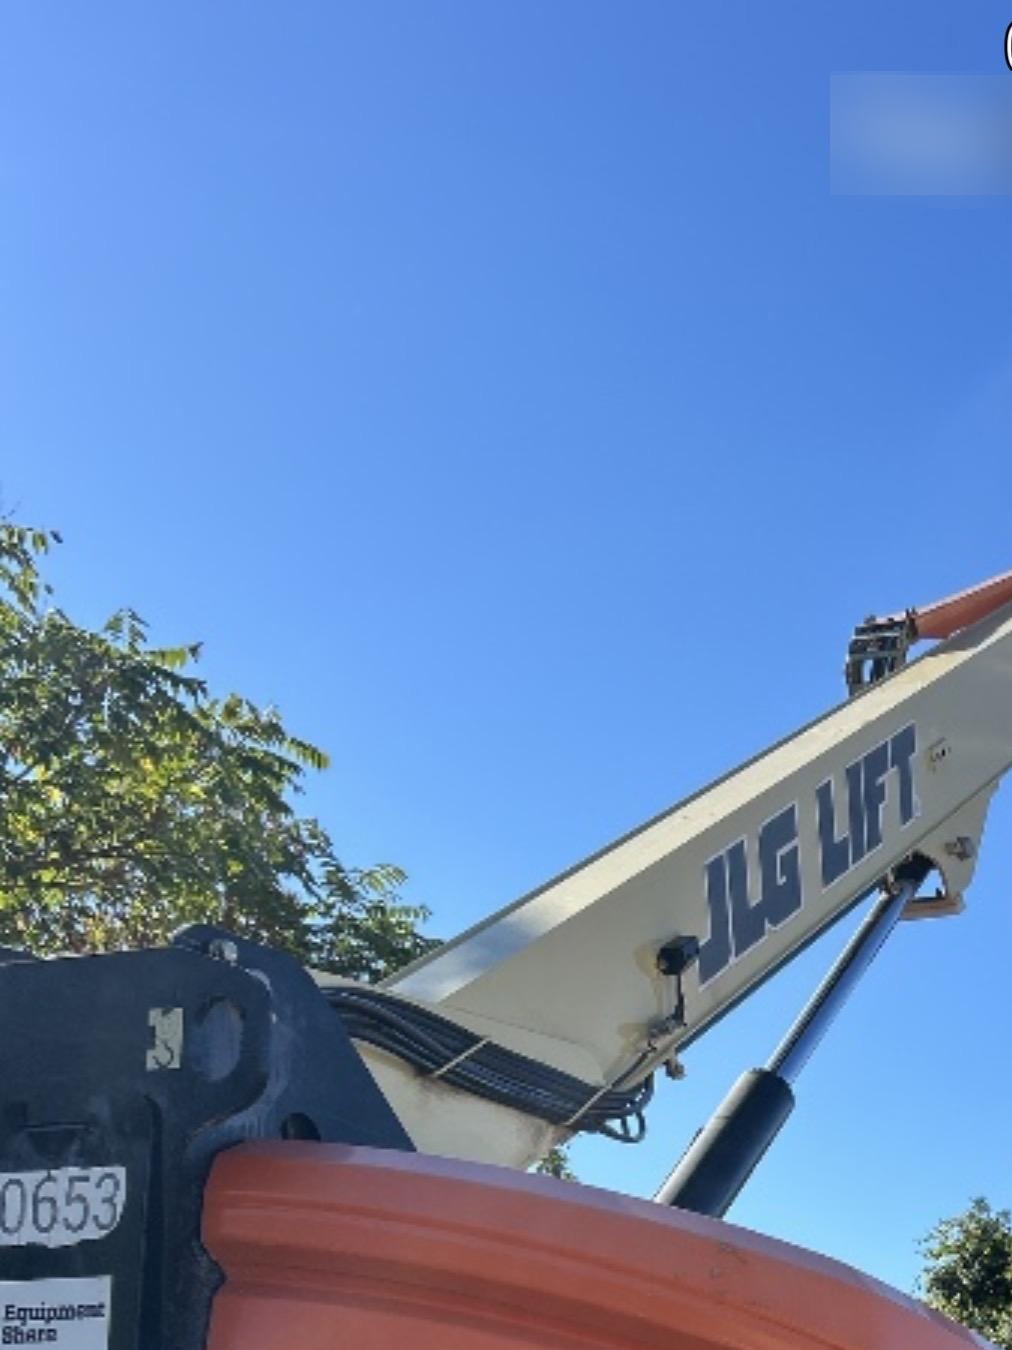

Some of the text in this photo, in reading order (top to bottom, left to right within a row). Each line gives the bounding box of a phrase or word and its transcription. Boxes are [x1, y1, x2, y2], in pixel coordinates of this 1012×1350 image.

[697, 720, 921, 991] JLG LIFT
[1, 1172, 119, 1234] 0653
[2, 1326, 57, 1344] Share
